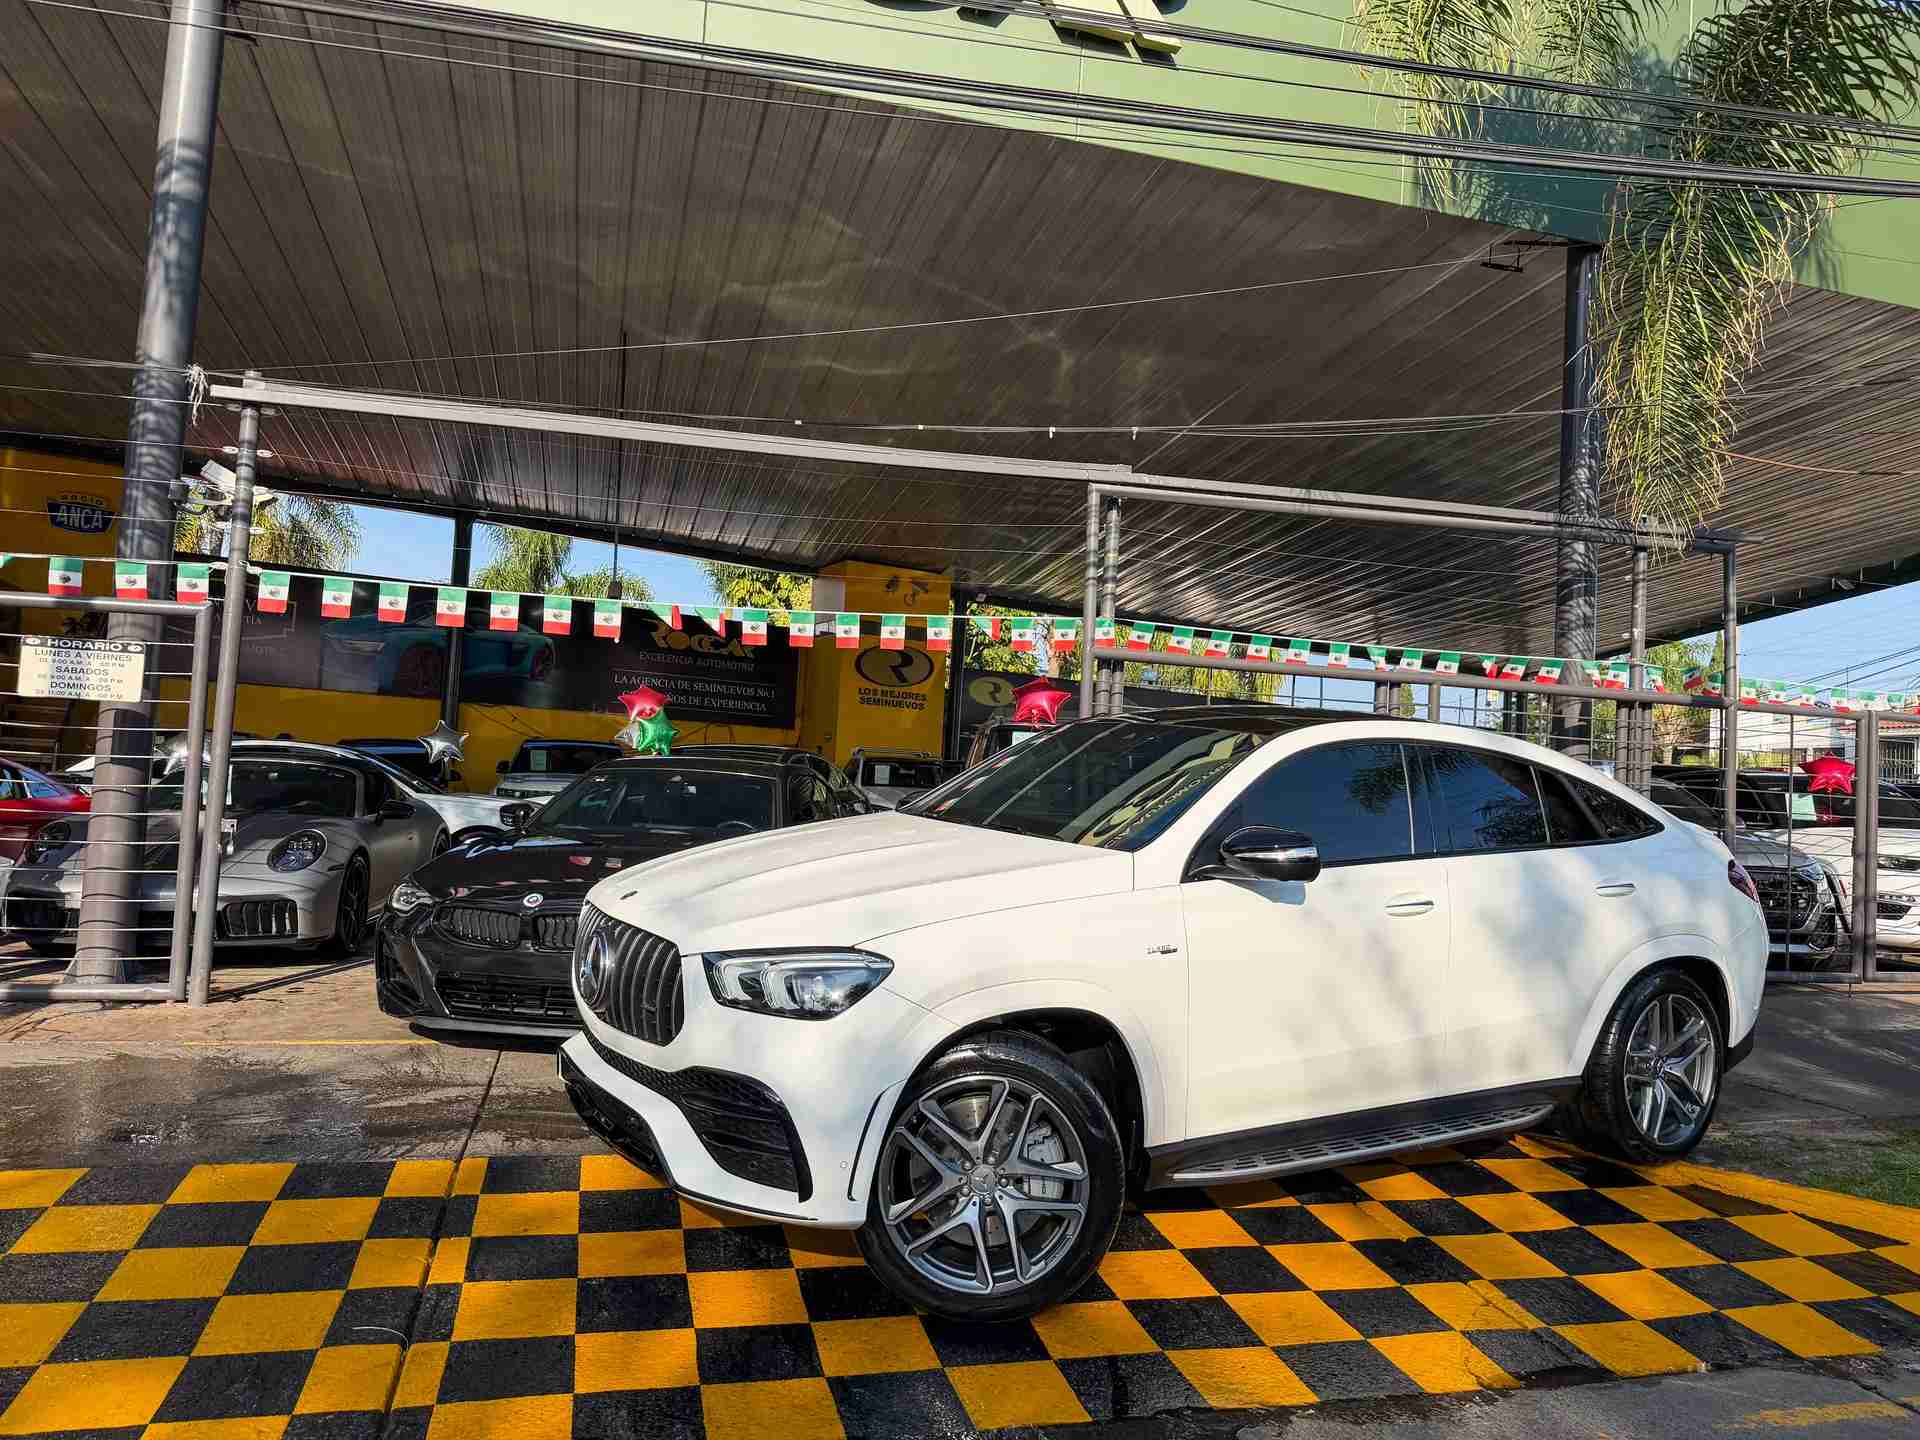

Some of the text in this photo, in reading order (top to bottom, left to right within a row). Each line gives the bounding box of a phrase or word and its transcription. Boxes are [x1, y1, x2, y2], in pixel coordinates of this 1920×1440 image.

[56, 505, 102, 528] ANCA
[47, 638, 122, 651] HORARIO
[34, 649, 132, 662] LUNES A VIERNES
[55, 666, 109, 676] SABADOS
[50, 681, 111, 692] DOMINGOS
[614, 673, 628, 684] LA
[629, 675, 675, 688] AGENCIA
[678, 679, 690, 688] DE
[693, 682, 755, 696] SEMINUEVOS
[858, 687, 927, 701] LOS MEJORES
[689, 695, 702, 705] DE
[704, 697, 768, 711] EXPERIENCIA
[858, 696, 926, 711] SEMINUEVOS
